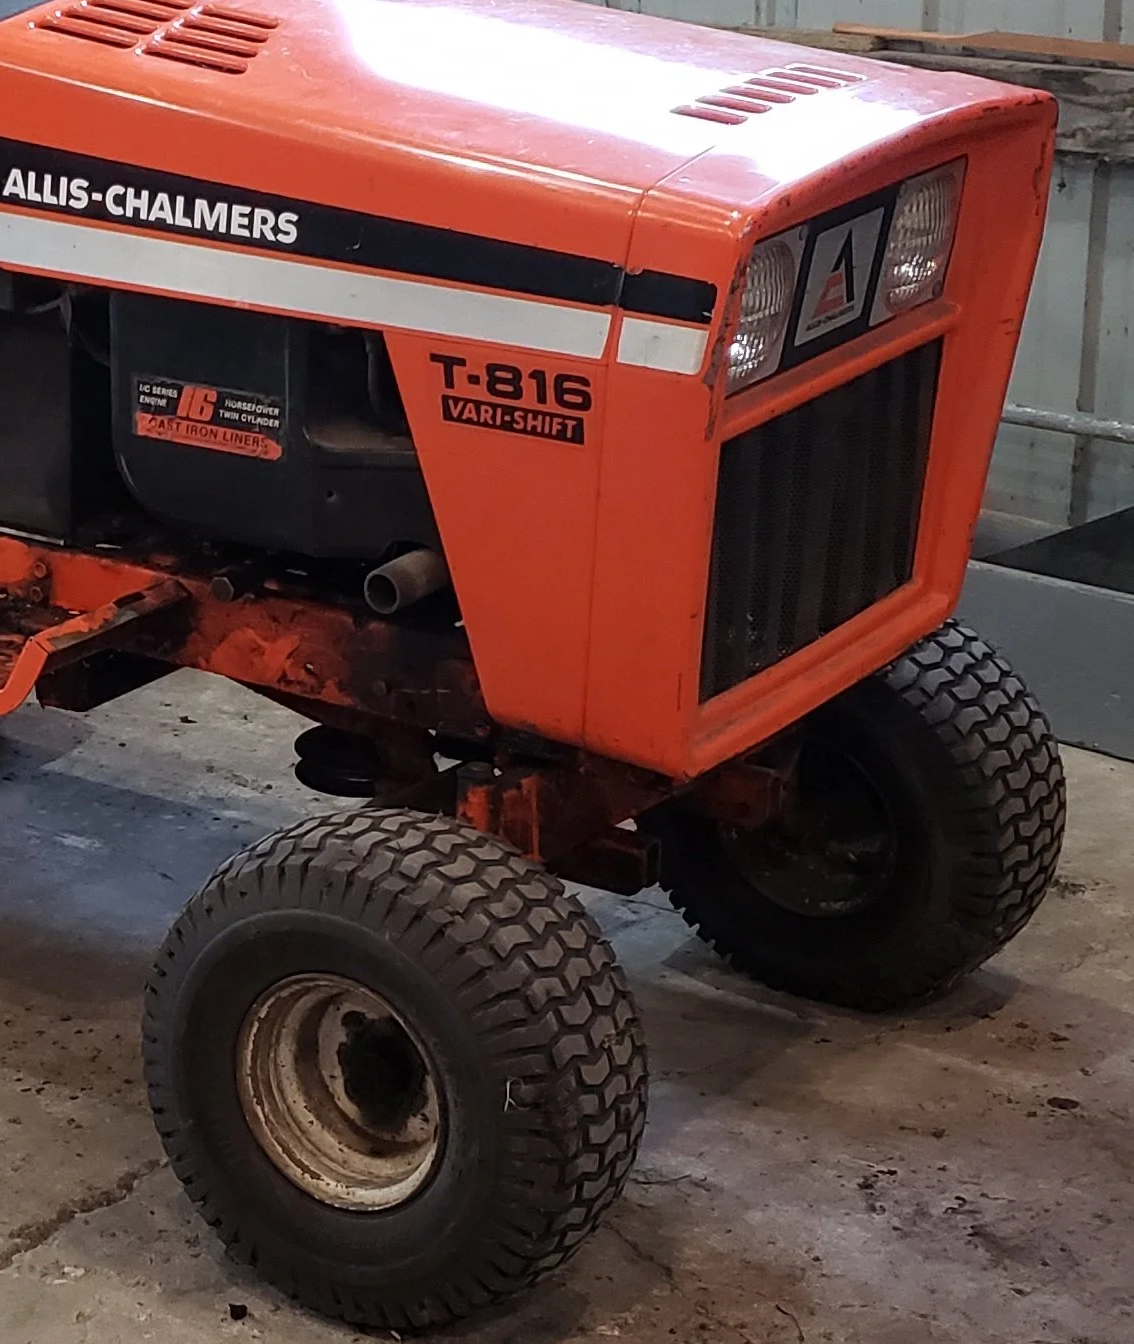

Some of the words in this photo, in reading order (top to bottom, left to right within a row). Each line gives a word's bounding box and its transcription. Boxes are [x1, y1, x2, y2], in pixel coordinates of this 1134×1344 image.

[2, 168, 299, 244] ALLIS-CHALMERS
[152, 385, 178, 398] SERIES
[430, 353, 592, 412] T-816
[139, 394, 167, 407] ENGINE
[177, 385, 218, 422] 16
[225, 399, 280, 416] HORSEPOWER
[149, 416, 181, 431] CAST
[186, 423, 218, 440] IRON
[222, 431, 268, 449] LINERS
[219, 409, 239, 421] TWIN
[241, 413, 280, 428] CYLINDER
[448, 399, 577, 439] VARI-SHIFT
